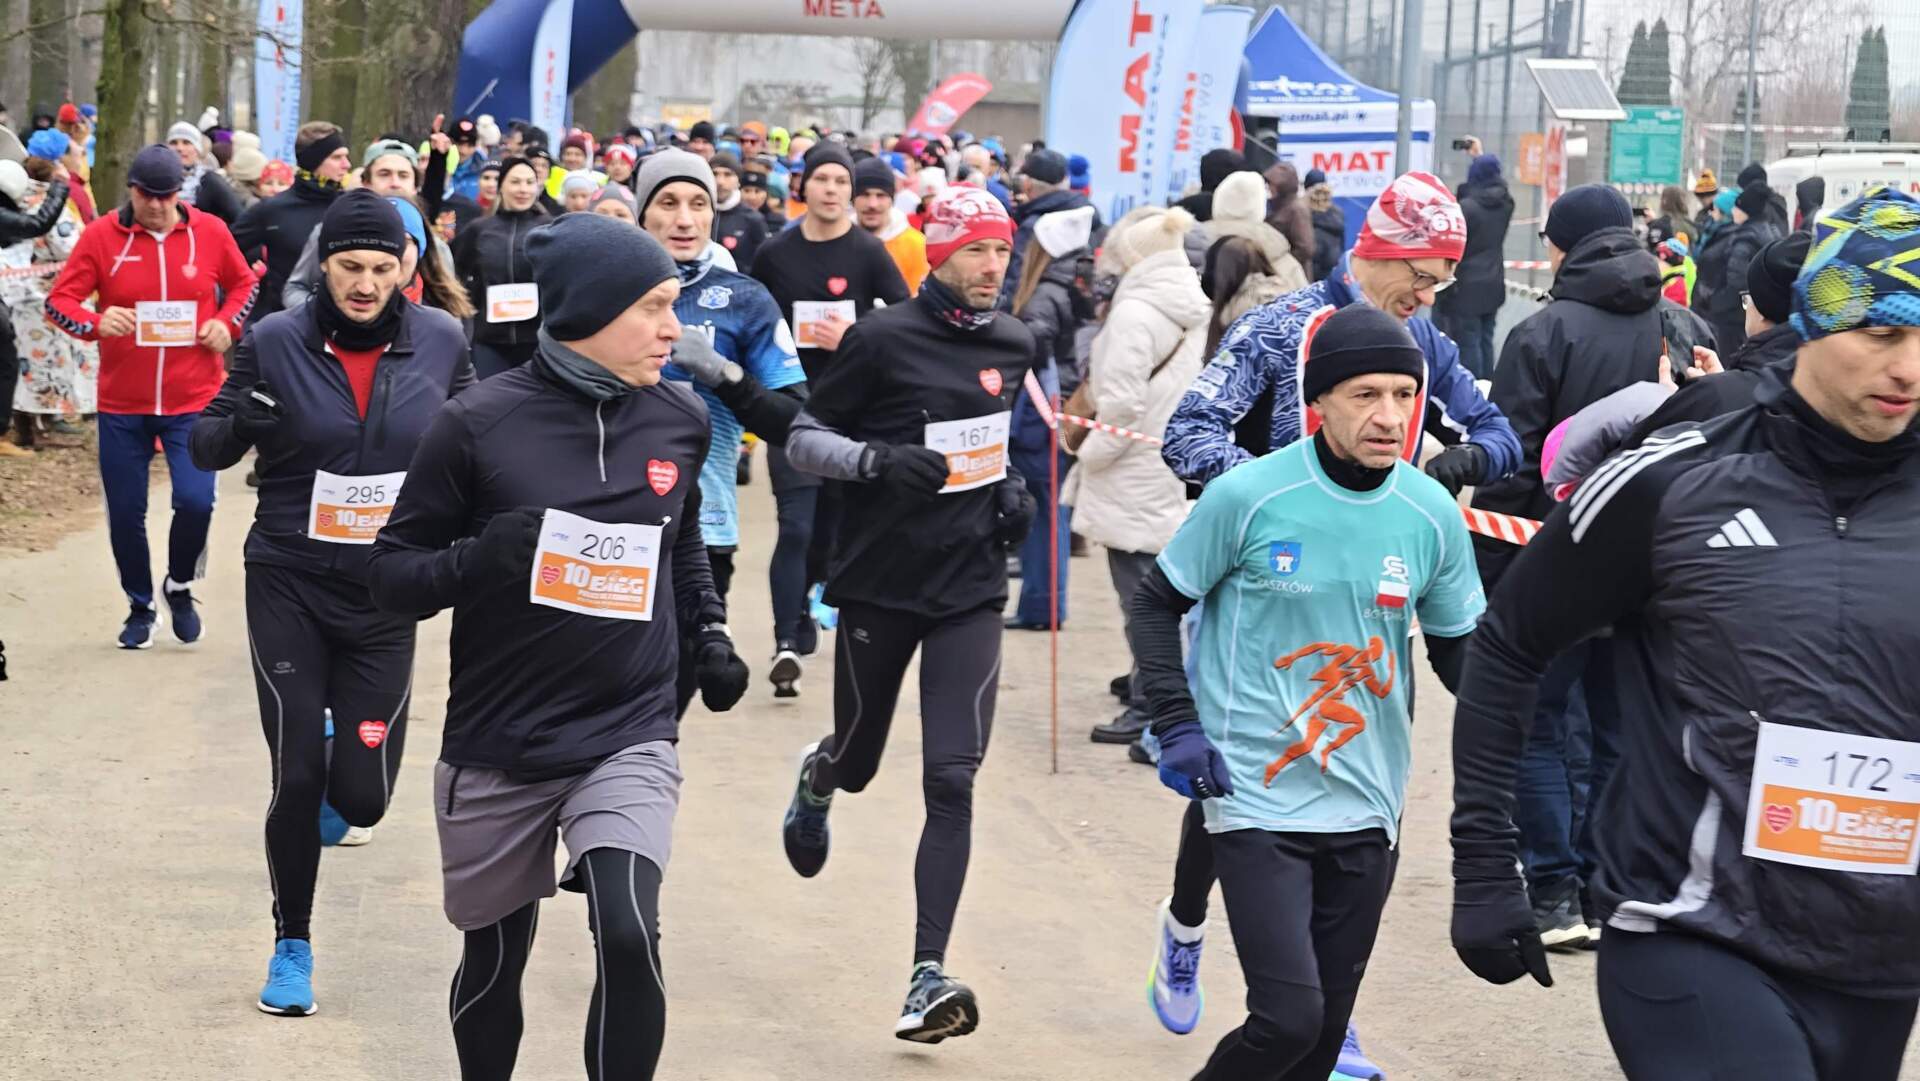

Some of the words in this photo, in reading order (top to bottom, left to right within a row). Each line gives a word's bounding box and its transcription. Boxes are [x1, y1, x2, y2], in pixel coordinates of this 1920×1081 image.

[803, 0, 886, 17] META
[1119, 0, 1153, 172] MAT
[1314, 151, 1391, 173] MAT
[156, 306, 182, 320] 058
[958, 426, 990, 448] 167
[346, 485, 385, 504] 295
[335, 509, 357, 527] 10
[580, 534, 626, 560] 206
[563, 562, 591, 587] 10
[1823, 751, 1893, 792] 172
[1796, 797, 1838, 833] 10
